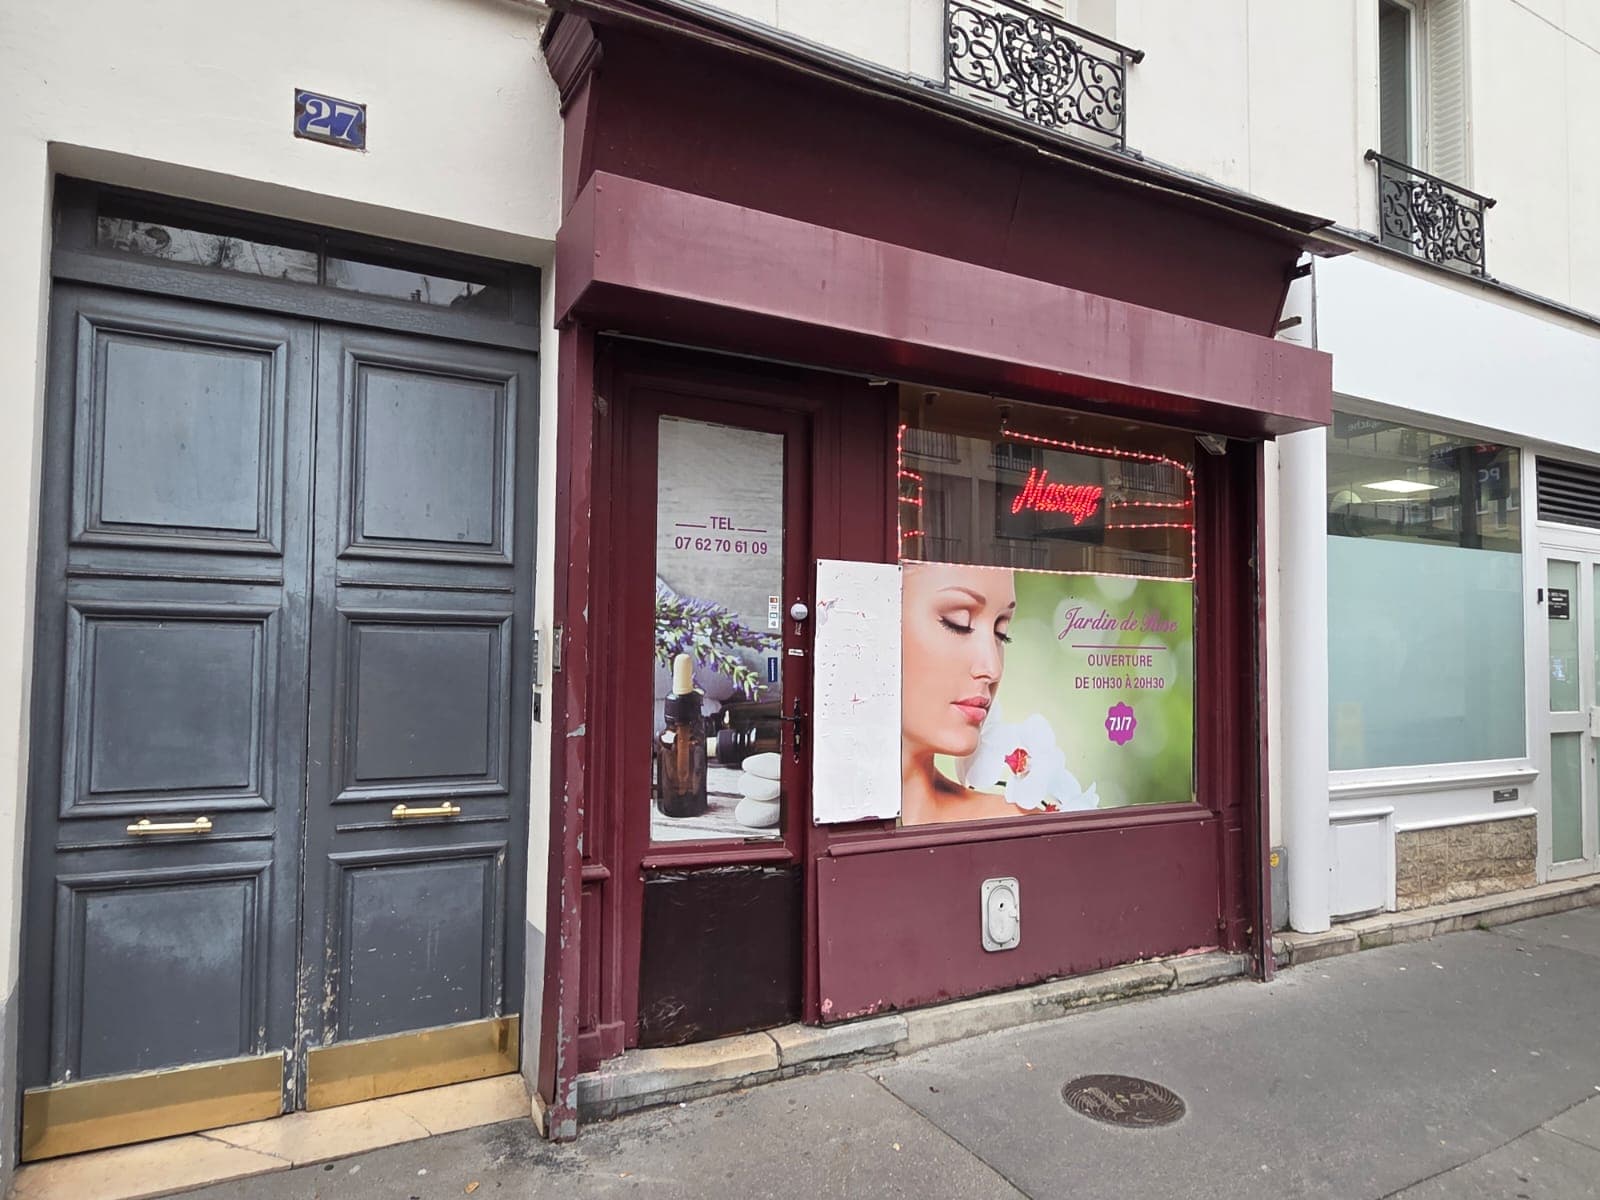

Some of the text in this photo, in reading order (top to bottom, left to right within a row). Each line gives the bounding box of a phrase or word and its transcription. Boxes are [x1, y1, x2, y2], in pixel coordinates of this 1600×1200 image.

[305, 98, 360, 141] 27
[1011, 466, 1103, 525] Massage
[710, 516, 735, 530] TEL
[675, 536, 767, 555] 07 62 70 61 09
[1058, 606, 1118, 640] Jardin
[1120, 609, 1138, 631] de
[1087, 654, 1153, 667] OUVERTURE
[1075, 673, 1165, 689] DE 10H30 À 20H30
[1109, 716, 1132, 731] 7J/7
